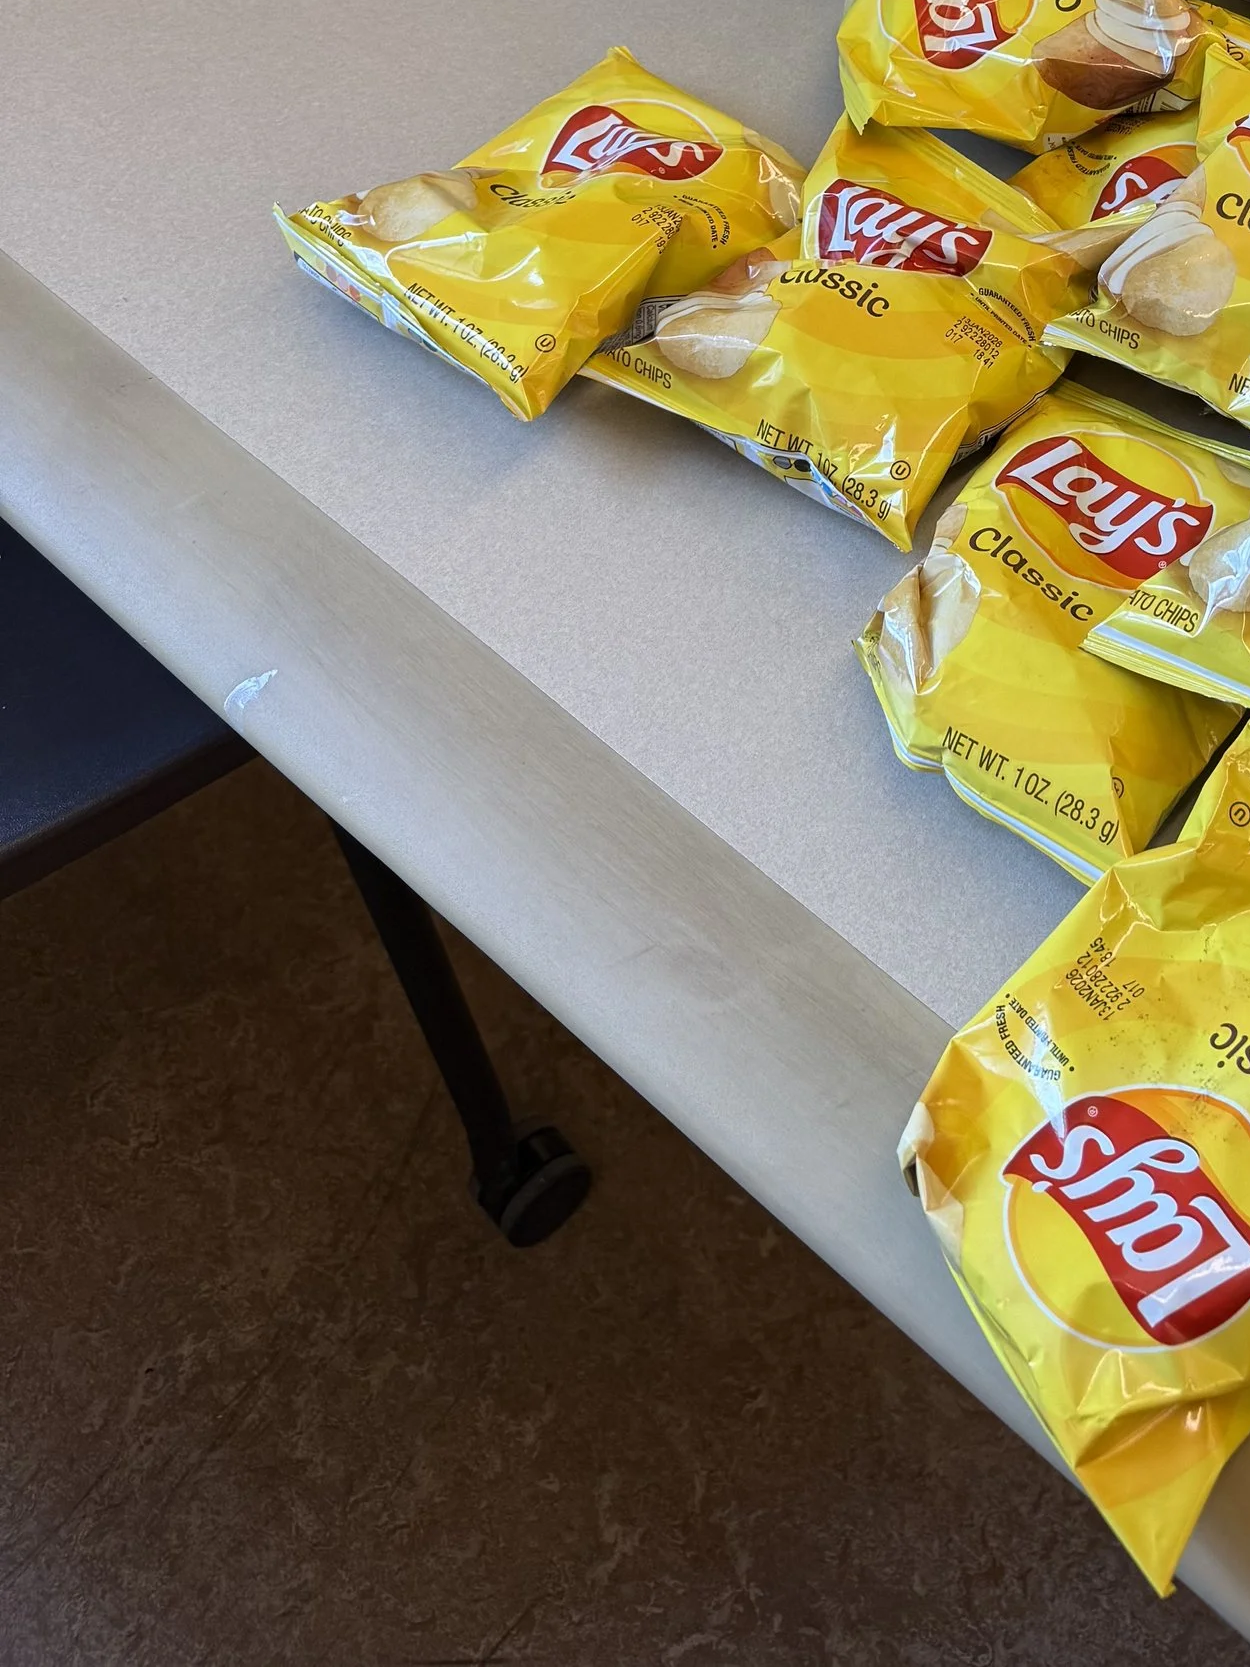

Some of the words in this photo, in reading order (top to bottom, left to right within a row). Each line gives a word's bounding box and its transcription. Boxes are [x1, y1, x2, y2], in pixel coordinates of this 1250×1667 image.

[488, 183, 576, 208] Classic
[631, 214, 650, 228] 017
[823, 187, 981, 272] Lay's
[404, 282, 432, 307] NET
[979, 287, 1022, 318] GUARANTEED
[1021, 317, 1036, 342] FRESH
[945, 329, 963, 344] 017
[961, 316, 1003, 348] 13JAN2026
[1099, 320, 1141, 351] CHIPS
[634, 358, 673, 389] CHIPS
[757, 419, 783, 448] NET
[841, 475, 878, 509] (28.3
[876, 497, 894, 521] g)
[1006, 437, 1201, 557] Lay's
[969, 526, 1094, 623] Classic
[1154, 596, 1199, 633] CHIPS
[941, 725, 978, 761] NET
[977, 746, 1011, 780] WT.
[1024, 771, 1050, 807] OZ.
[1053, 789, 1099, 830] (28.3
[1097, 817, 1122, 846] g)
[1065, 968, 1115, 1021] 13JAN2026
[1122, 979, 1145, 998] 017
[995, 1005, 1010, 1040] FRESH
[1008, 997, 1028, 1019] DATE
[1004, 1039, 1061, 1081] GUARANTEED
[1049, 1043, 1070, 1067] UNTIL
